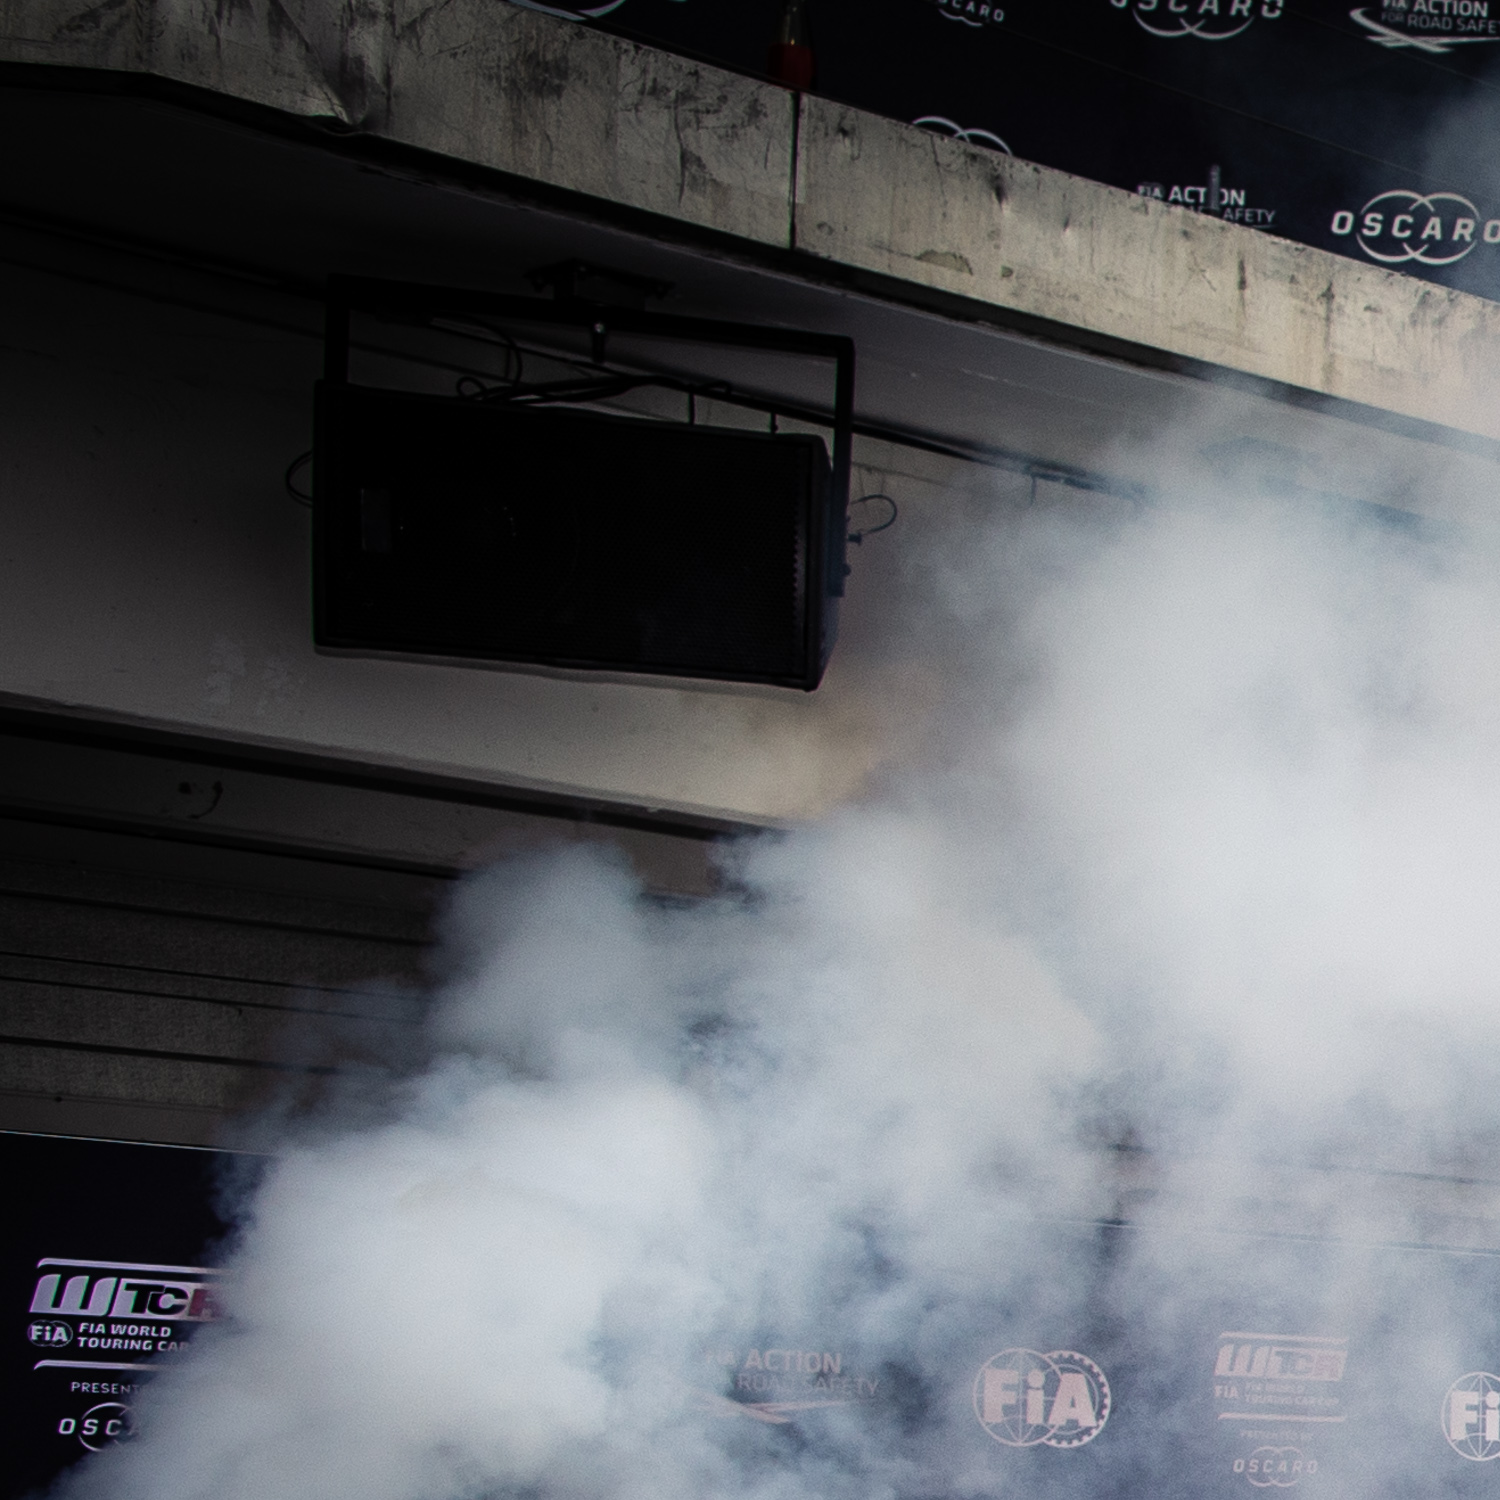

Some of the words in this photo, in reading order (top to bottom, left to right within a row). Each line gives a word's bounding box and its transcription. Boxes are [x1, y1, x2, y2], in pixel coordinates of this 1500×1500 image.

[1413, 0, 1488, 17] ACTION
[1408, 13, 1453, 31] ROAD
[79, 1322, 105, 1336] FIA
[110, 1324, 171, 1338] WORLD
[78, 1336, 153, 1352] TOURING
[744, 1348, 842, 1375] ACTION
